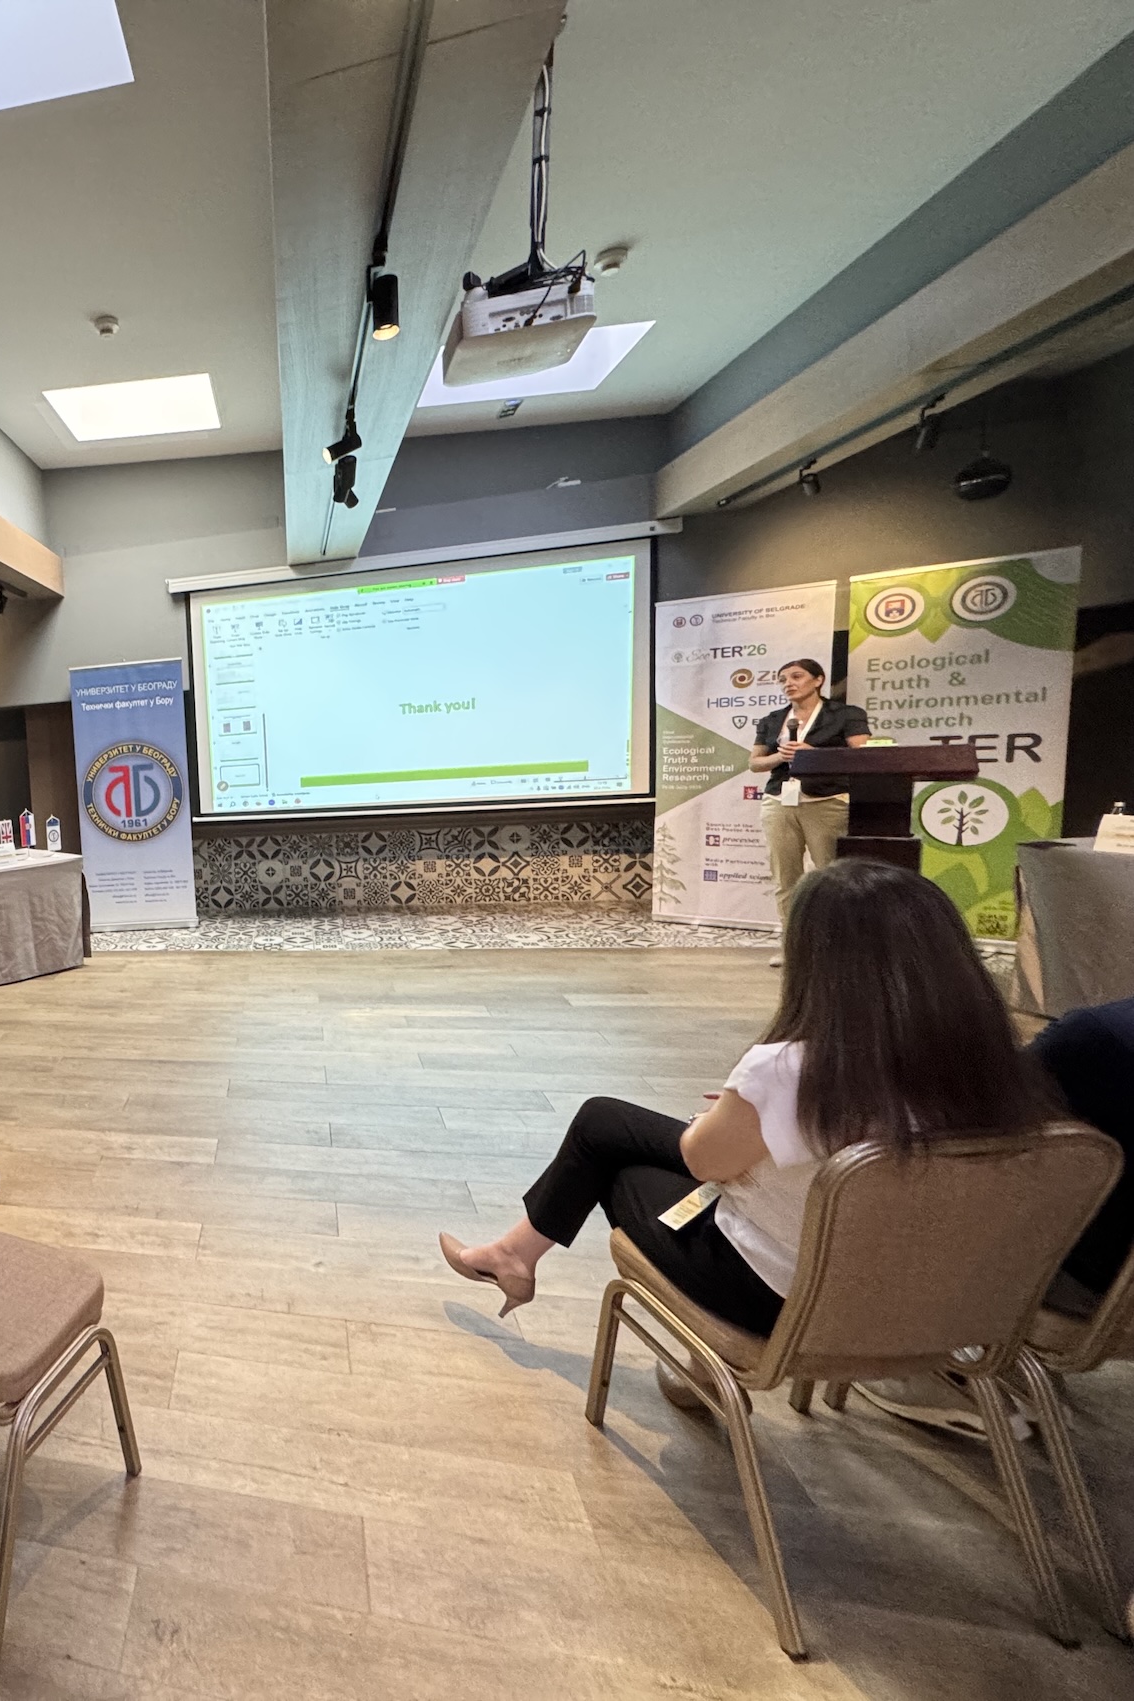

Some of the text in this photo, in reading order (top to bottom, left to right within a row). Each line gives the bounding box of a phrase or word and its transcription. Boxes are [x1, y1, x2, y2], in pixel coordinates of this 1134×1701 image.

[712, 609, 753, 619] UNIVERSITY
[765, 604, 806, 613] BELGRADE
[867, 649, 991, 673] Ecological
[75, 680, 178, 697] УНИВЕРЗИТЕТ У БЕОГРАДУ
[866, 671, 966, 692] Truth &
[81, 702, 114, 712] Технички
[115, 698, 149, 711] факултет
[156, 696, 174, 707] Бору
[399, 697, 476, 715] Thank you!
[707, 695, 788, 709] HBIS SERB
[866, 686, 1048, 711] Environmental
[866, 711, 973, 731] Research
[662, 746, 715, 757] Ecological
[86, 744, 134, 782] УНИВЕРЗИТЕТ
[142, 746, 178, 778] БЕОГРАДУ
[662, 756, 688, 764] Truth
[662, 764, 735, 773] Environmental
[662, 773, 709, 782] Research
[86, 803, 119, 838] ТЕХНИЧКИ
[120, 826, 163, 841] ФАКУЛТЕТ
[168, 797, 181, 822] БОРУ
[120, 818, 148, 828] 1961
[719, 872, 748, 881] applied
